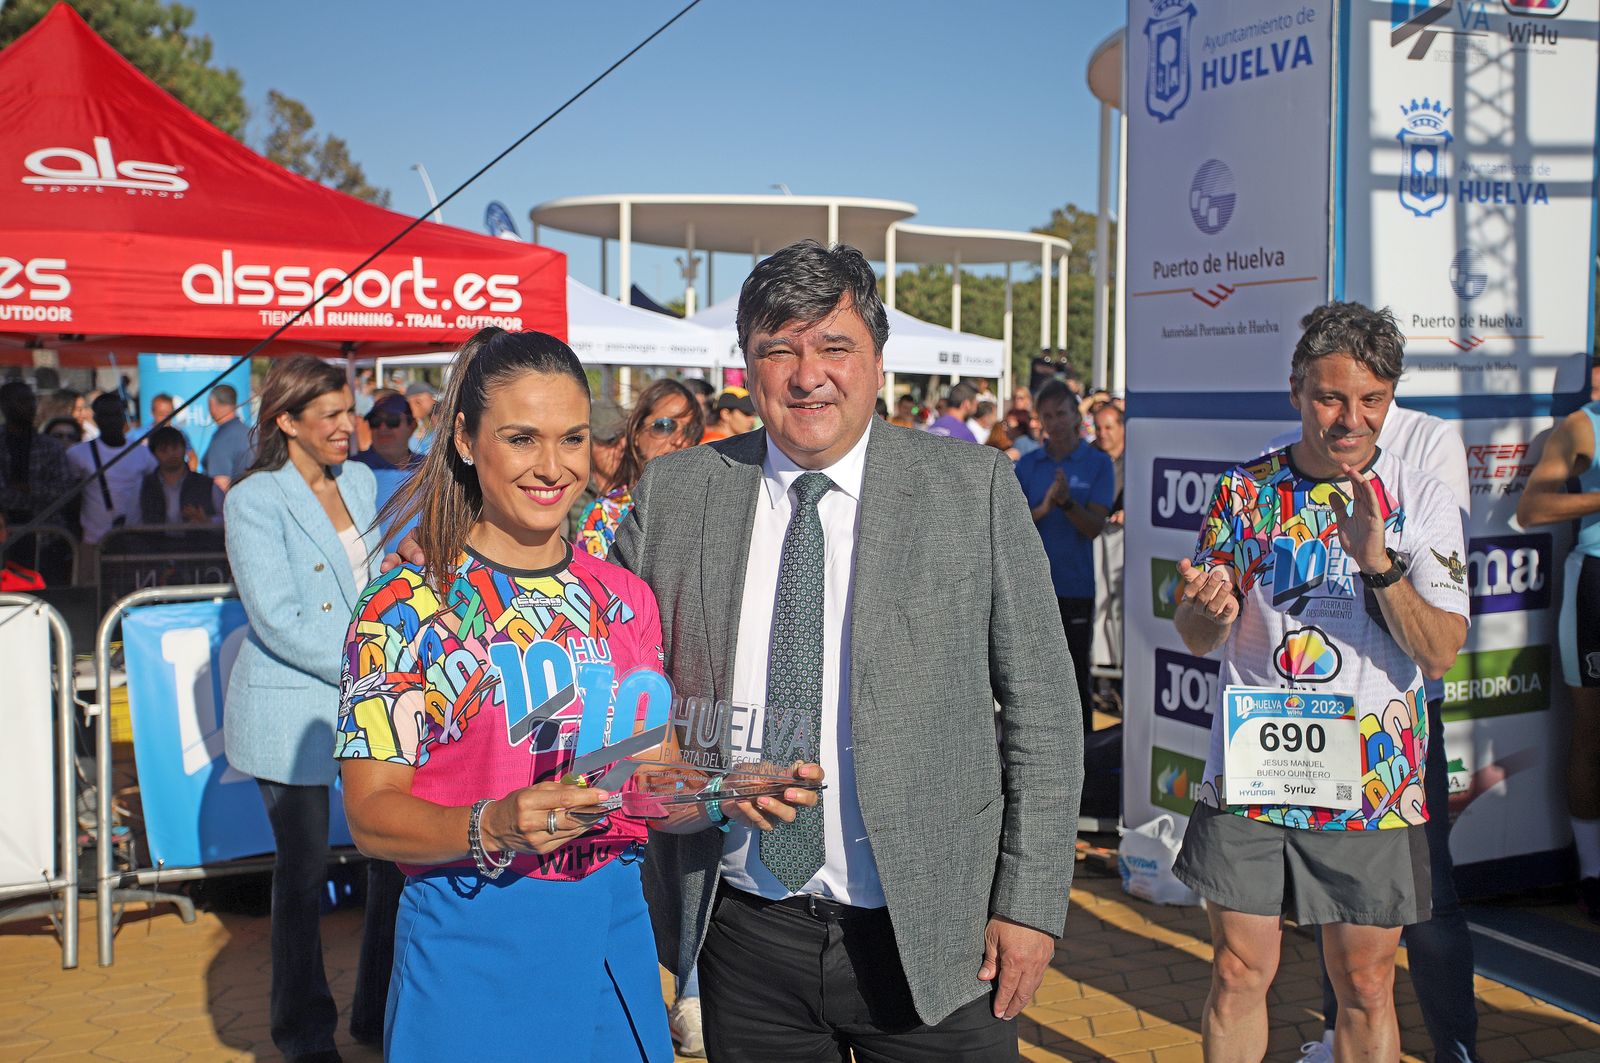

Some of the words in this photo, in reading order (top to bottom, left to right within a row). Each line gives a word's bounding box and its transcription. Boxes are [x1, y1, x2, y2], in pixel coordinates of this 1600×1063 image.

[1203, 14, 1293, 52] Ayuntamiento
[1295, 6, 1316, 27] de
[1508, 21, 1559, 46] WiHu
[1201, 34, 1314, 92] HUELVA
[22, 136, 190, 192] als
[1537, 160, 1551, 177] de
[1458, 179, 1549, 206] HUELVA
[1152, 257, 1199, 280] Puerto
[1203, 252, 1222, 274] de
[1226, 246, 1286, 272] Huelva
[181, 249, 524, 327] alssport.es
[1249, 319, 1280, 335] Huelva
[1411, 313, 1456, 329] Puerto
[1459, 313, 1475, 329] de
[1479, 313, 1524, 329] Huelva
[1326, 576, 1357, 597] VA
[1305, 608, 1353, 620] DESCUBRIMIENTO
[1320, 600, 1341, 610] PUERTA
[1342, 601, 1353, 611] DEL
[1253, 699, 1282, 710] HUELVA
[1311, 699, 1345, 715] 2023
[666, 700, 812, 760] HUELVA
[1259, 722, 1326, 753] 690
[702, 751, 721, 769] DEL
[1261, 759, 1289, 768] JESUS
[1290, 759, 1325, 769] MANUEL
[1256, 769, 1286, 778] BUENO
[1287, 769, 1331, 780] QUINTERO
[1283, 783, 1317, 796] Syrluz
[536, 841, 612, 876] WiHu
